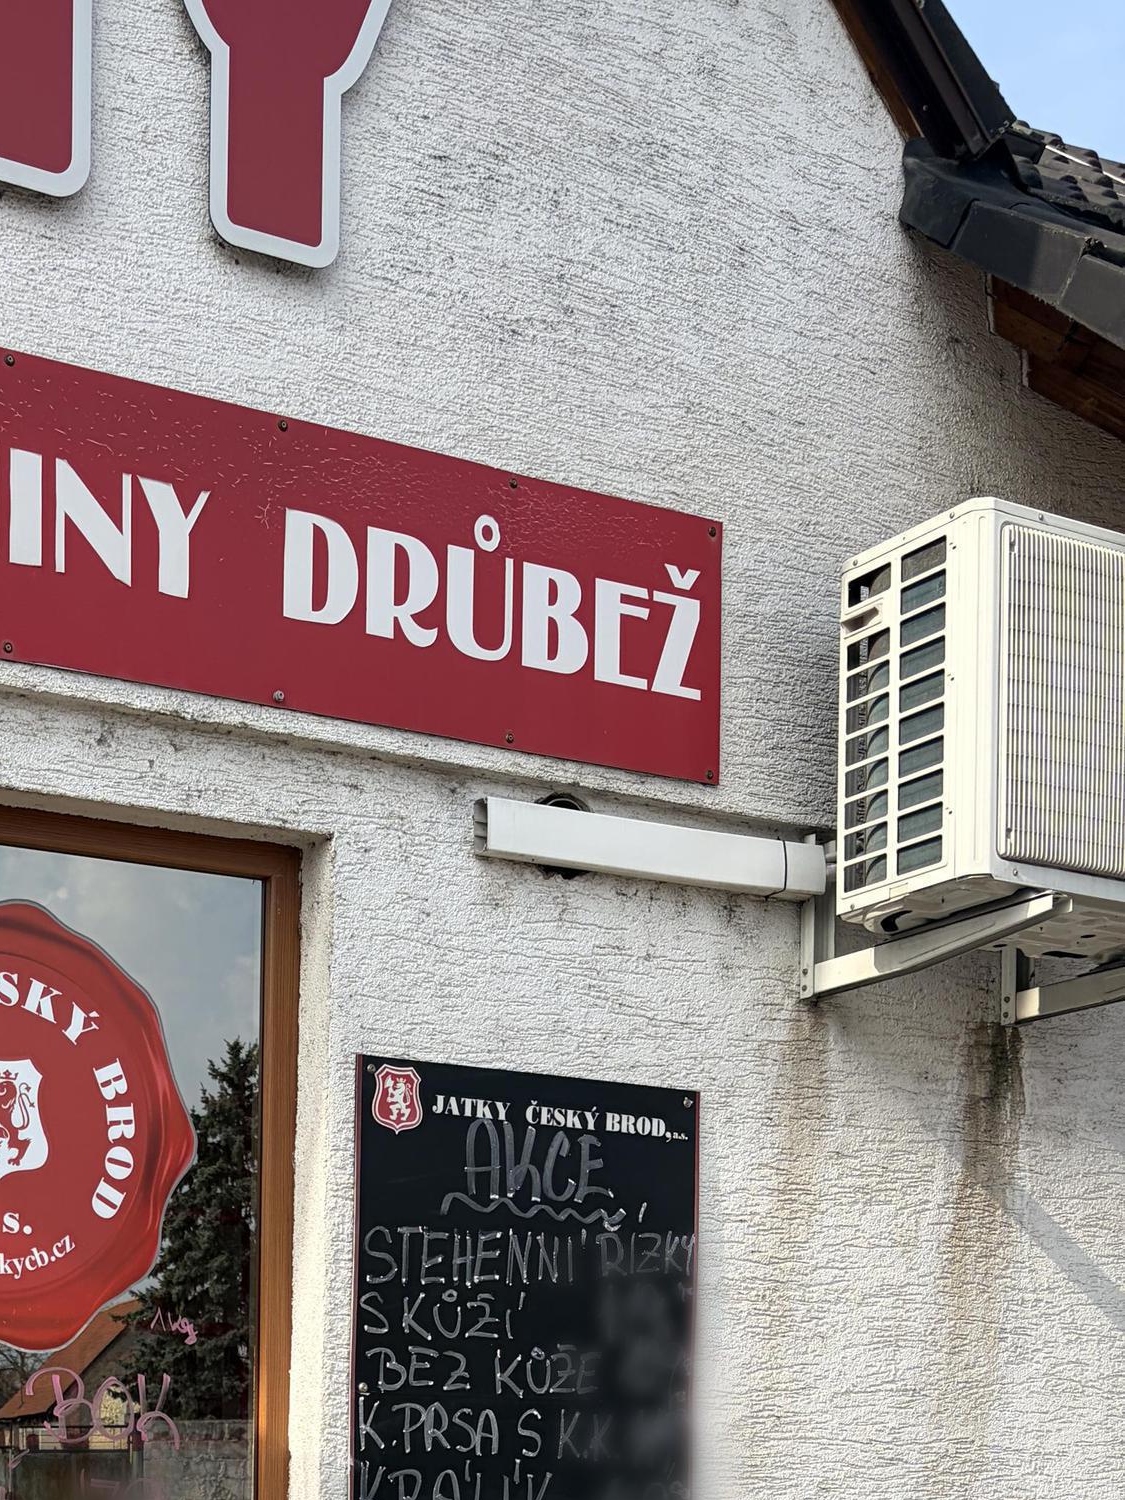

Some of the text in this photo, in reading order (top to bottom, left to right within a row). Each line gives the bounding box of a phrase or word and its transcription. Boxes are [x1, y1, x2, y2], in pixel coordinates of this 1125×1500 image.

[283, 514, 702, 701] DRŮBEŽ
[91, 1058, 136, 1220] BROD
[432, 1094, 511, 1121] JATKY
[525, 1100, 600, 1130] ČESKÝ
[464, 1117, 614, 1203] AKCE
[364, 1225, 587, 1288] STEHENNÍ
[25, 1366, 181, 1450] BOK
[365, 1345, 471, 1393] BEZ
